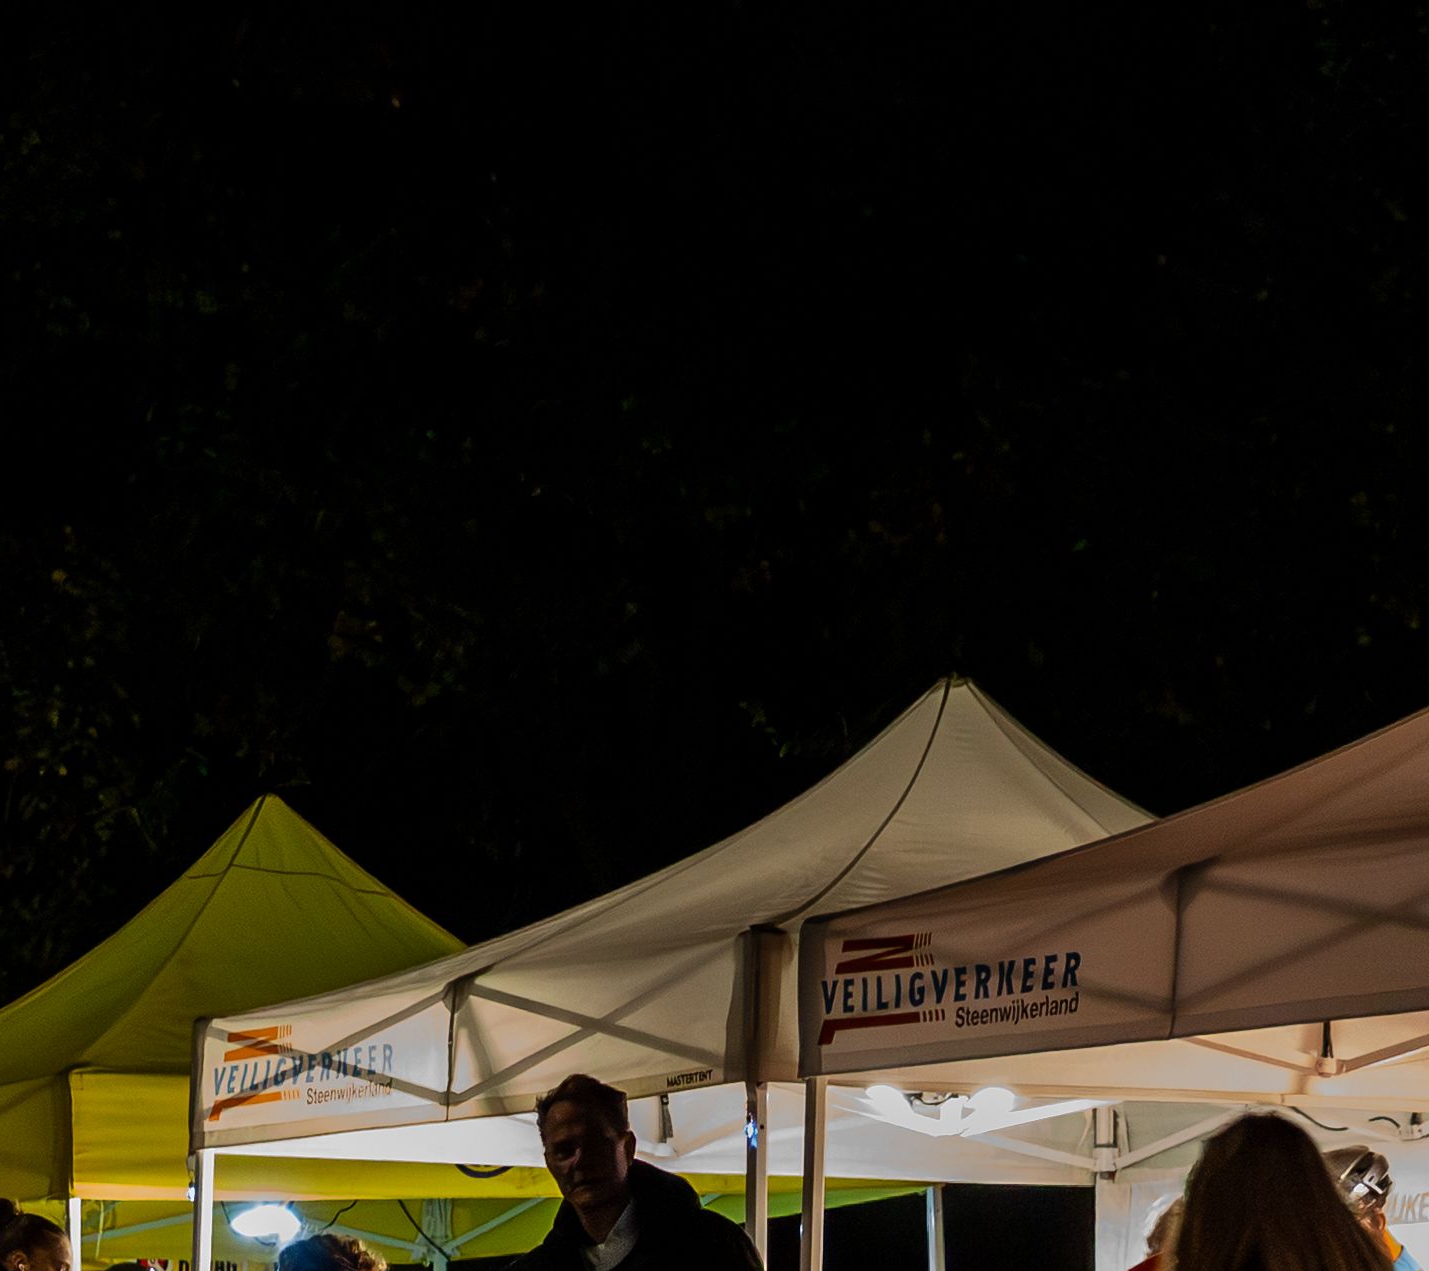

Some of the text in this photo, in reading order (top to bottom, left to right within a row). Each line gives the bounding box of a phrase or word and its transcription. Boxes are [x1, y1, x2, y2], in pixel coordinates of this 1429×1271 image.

[821, 952, 1082, 1015] VEILIGVERKEER
[954, 992, 1081, 1028] Steenwijkerland
[213, 1044, 394, 1096] VEILIGVERKEER
[666, 1069, 713, 1088] MASTERTENT
[306, 1077, 393, 1105] Steenwijkerland
